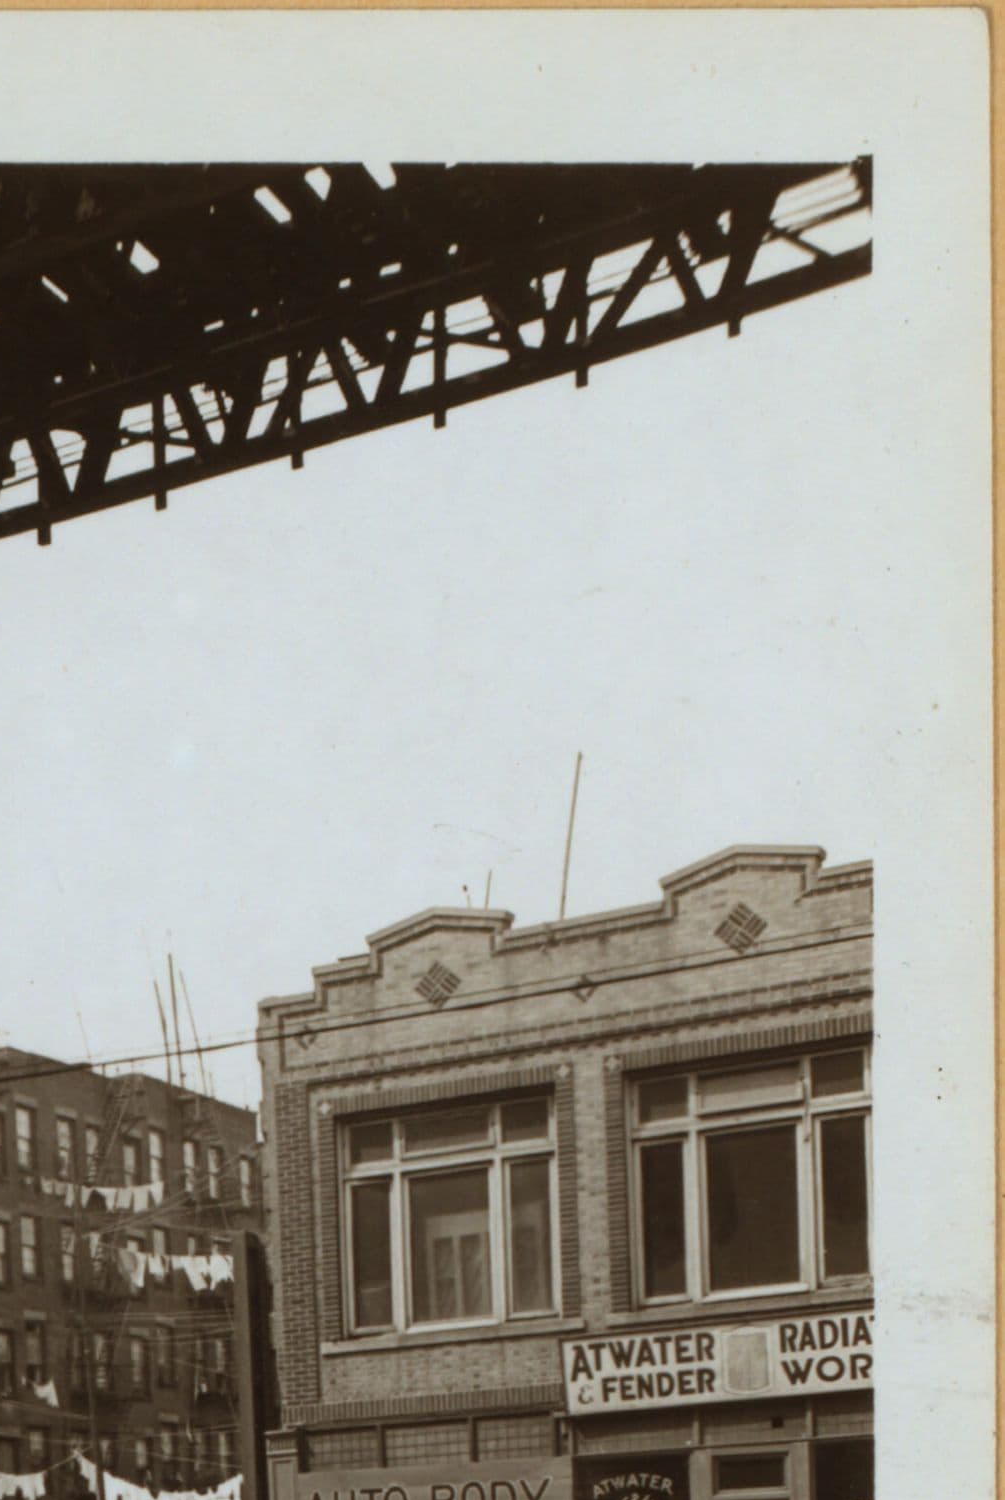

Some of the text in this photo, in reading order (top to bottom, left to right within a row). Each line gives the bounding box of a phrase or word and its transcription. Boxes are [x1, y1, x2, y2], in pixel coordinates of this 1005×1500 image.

[571, 1315, 875, 1382] ATWATER RADIA
[577, 1353, 874, 1405] & FENDER WOR
[593, 1472, 674, 1500] ATWATER
